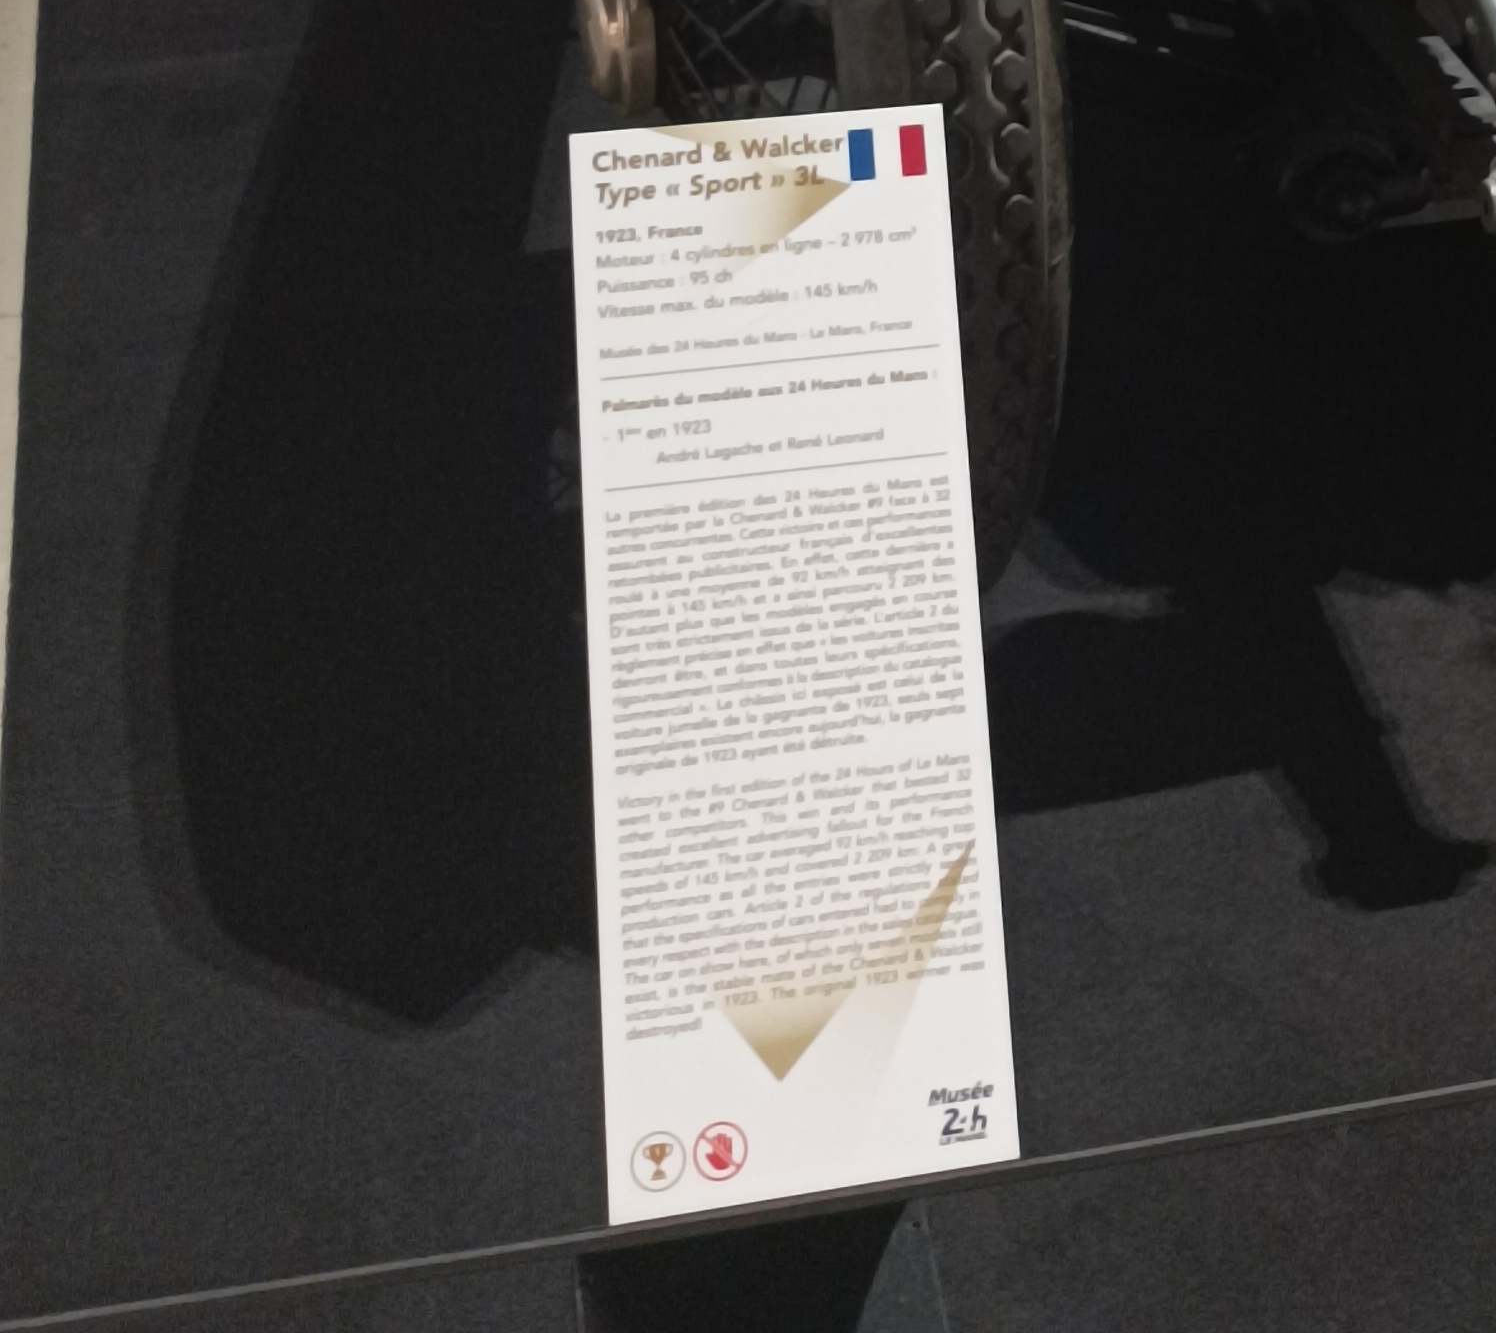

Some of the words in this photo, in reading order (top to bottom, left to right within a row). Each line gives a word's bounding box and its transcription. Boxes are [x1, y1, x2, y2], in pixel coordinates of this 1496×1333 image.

[592, 143, 701, 172] Chenard
[714, 140, 730, 161] &
[741, 131, 843, 159] Walcker
[596, 180, 655, 209] Type
[666, 183, 679, 196] «
[689, 170, 762, 201] Sport
[771, 173, 784, 187] »
[794, 165, 823, 185] 3L
[595, 227, 640, 246] 1923,
[647, 222, 703, 239] France
[595, 251, 654, 269] Moteur
[669, 249, 679, 262] 4
[685, 241, 755, 264] cylindres
[759, 242, 778, 254] en
[784, 235, 822, 254] ligne
[840, 233, 849, 246] 2
[854, 230, 883, 245] 978
[596, 274, 674, 294] Puissance
[689, 271, 709, 285] 95
[714, 268, 733, 283] ch
[597, 301, 654, 319] Vitesse
[660, 300, 696, 313] max.
[703, 294, 723, 309] du
[729, 288, 789, 306] modèle
[805, 283, 832, 299] 145
[837, 279, 877, 295] km/h
[601, 394, 669, 413] Palmarès
[673, 391, 693, 405] du
[697, 385, 753, 403] modèle
[757, 385, 782, 397] aux
[787, 380, 806, 394] 24
[810, 374, 862, 391] Heures
[867, 372, 885, 386] du
[890, 368, 928, 383] Mans
[646, 427, 666, 439] en
[673, 419, 711, 436] 1923
[656, 447, 699, 463] André
[768, 440, 782, 451] et
[927, 1080, 995, 1107] Musée
[941, 1104, 988, 1136] 2h
